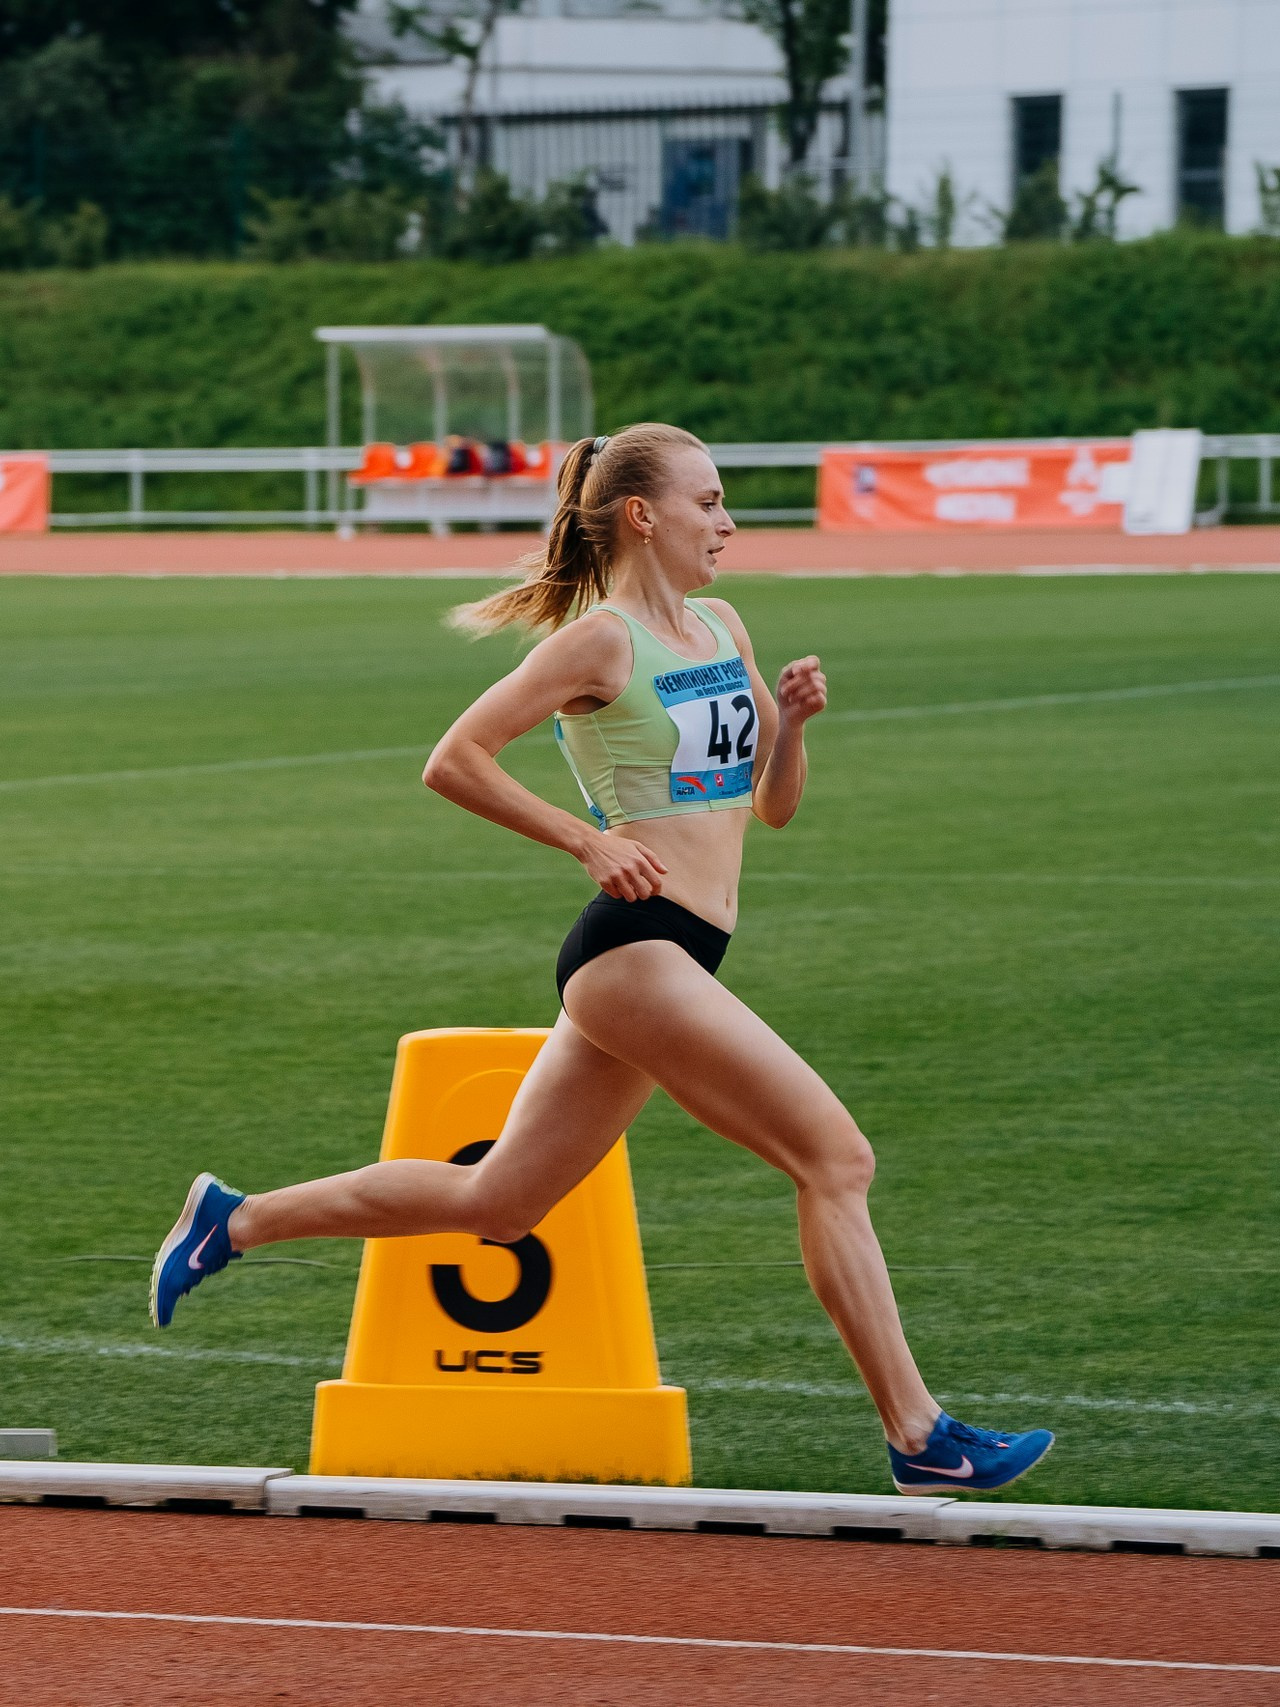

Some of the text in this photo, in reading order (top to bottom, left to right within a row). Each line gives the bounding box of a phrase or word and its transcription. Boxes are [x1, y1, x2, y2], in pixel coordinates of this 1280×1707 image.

[655, 665, 724, 694] ЧЕМПИОНАТ
[707, 694, 755, 765] 42
[433, 1349, 546, 1375] UCS
